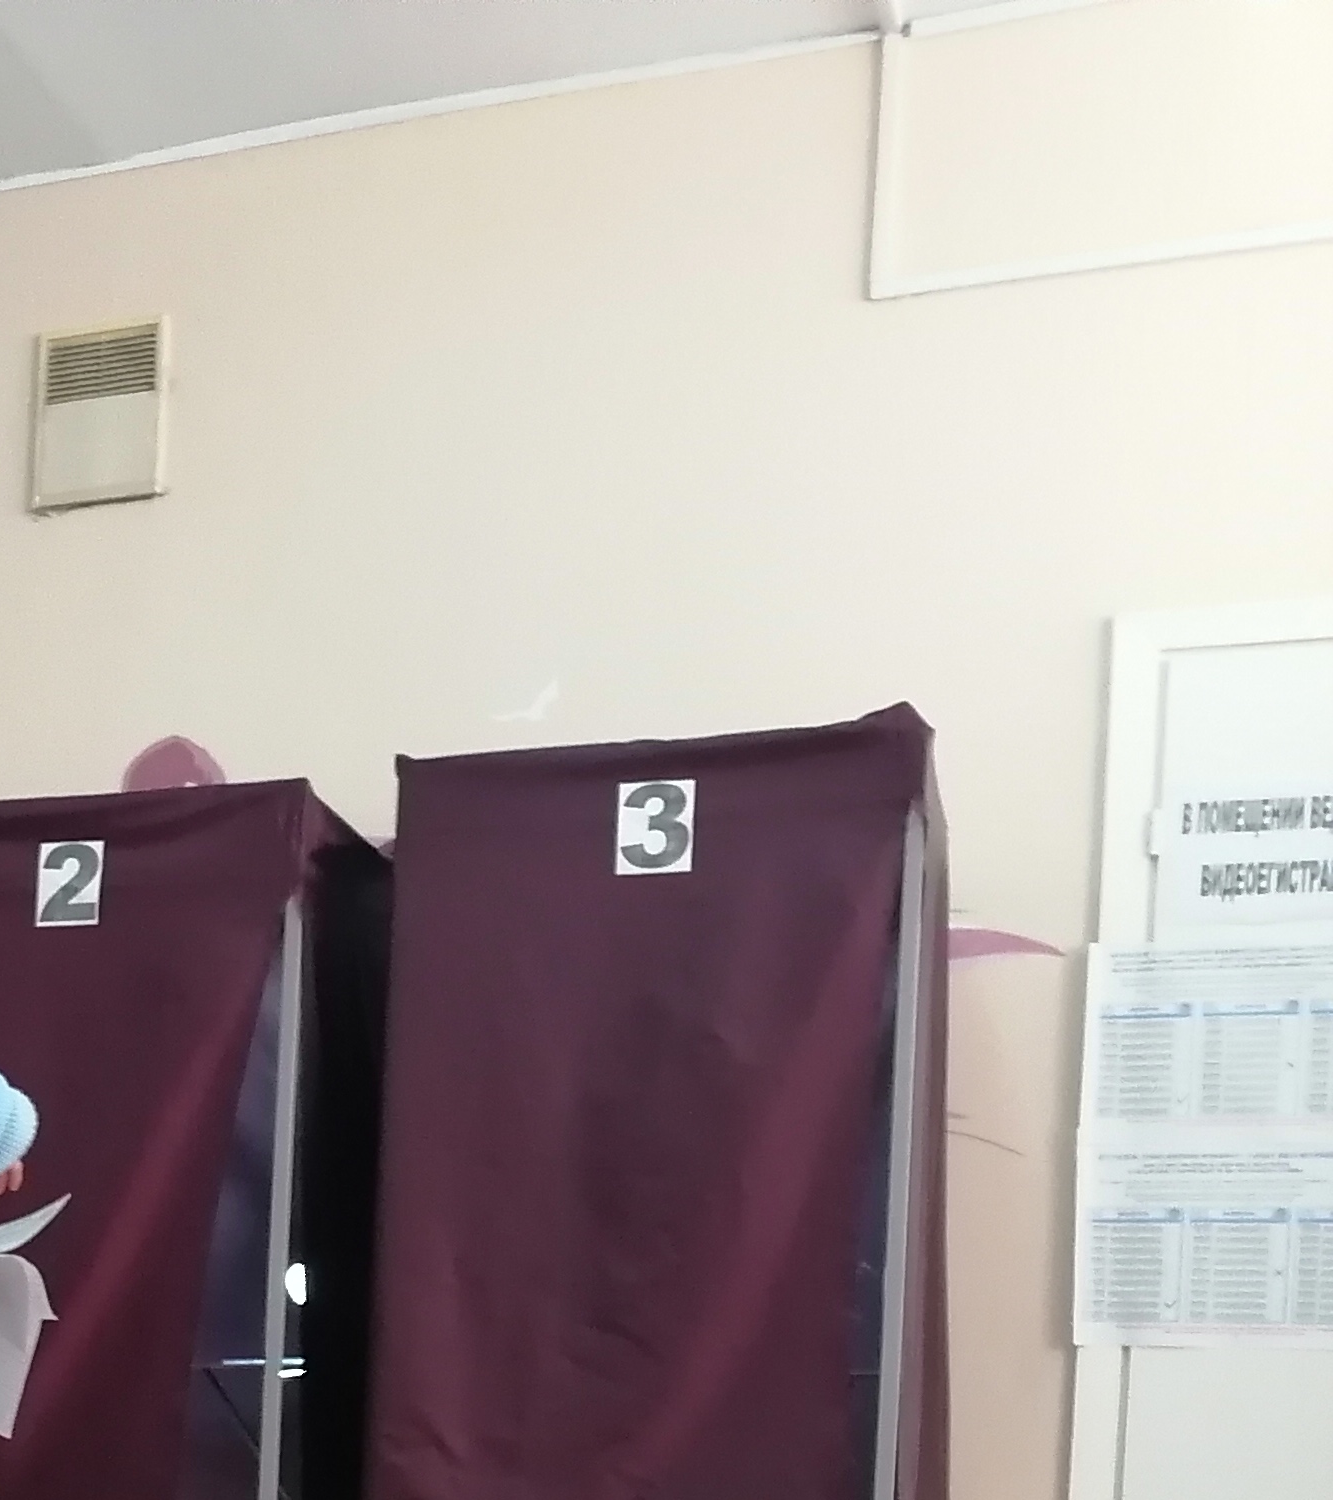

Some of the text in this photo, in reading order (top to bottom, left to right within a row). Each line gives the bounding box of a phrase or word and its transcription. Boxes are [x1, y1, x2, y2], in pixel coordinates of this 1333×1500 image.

[621, 784, 692, 872] 3
[1310, 795, 1333, 830] ВЕ
[40, 844, 100, 922] 2
